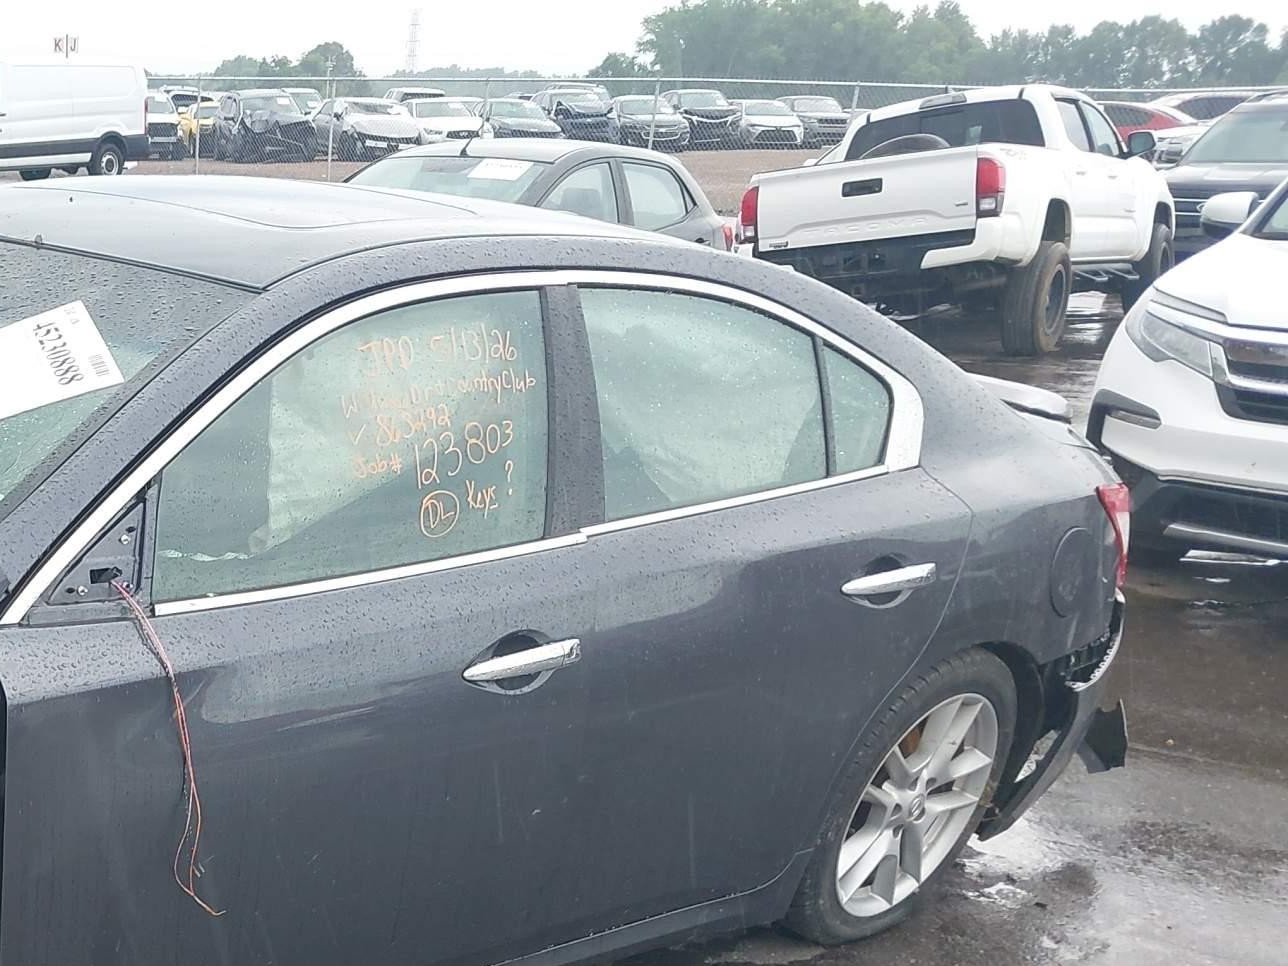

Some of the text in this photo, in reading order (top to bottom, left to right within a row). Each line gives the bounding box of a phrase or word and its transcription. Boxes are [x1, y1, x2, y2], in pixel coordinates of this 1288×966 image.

[54, 38, 63, 52] K
[32, 321, 84, 386] 45230888
[414, 420, 514, 489] 123803
